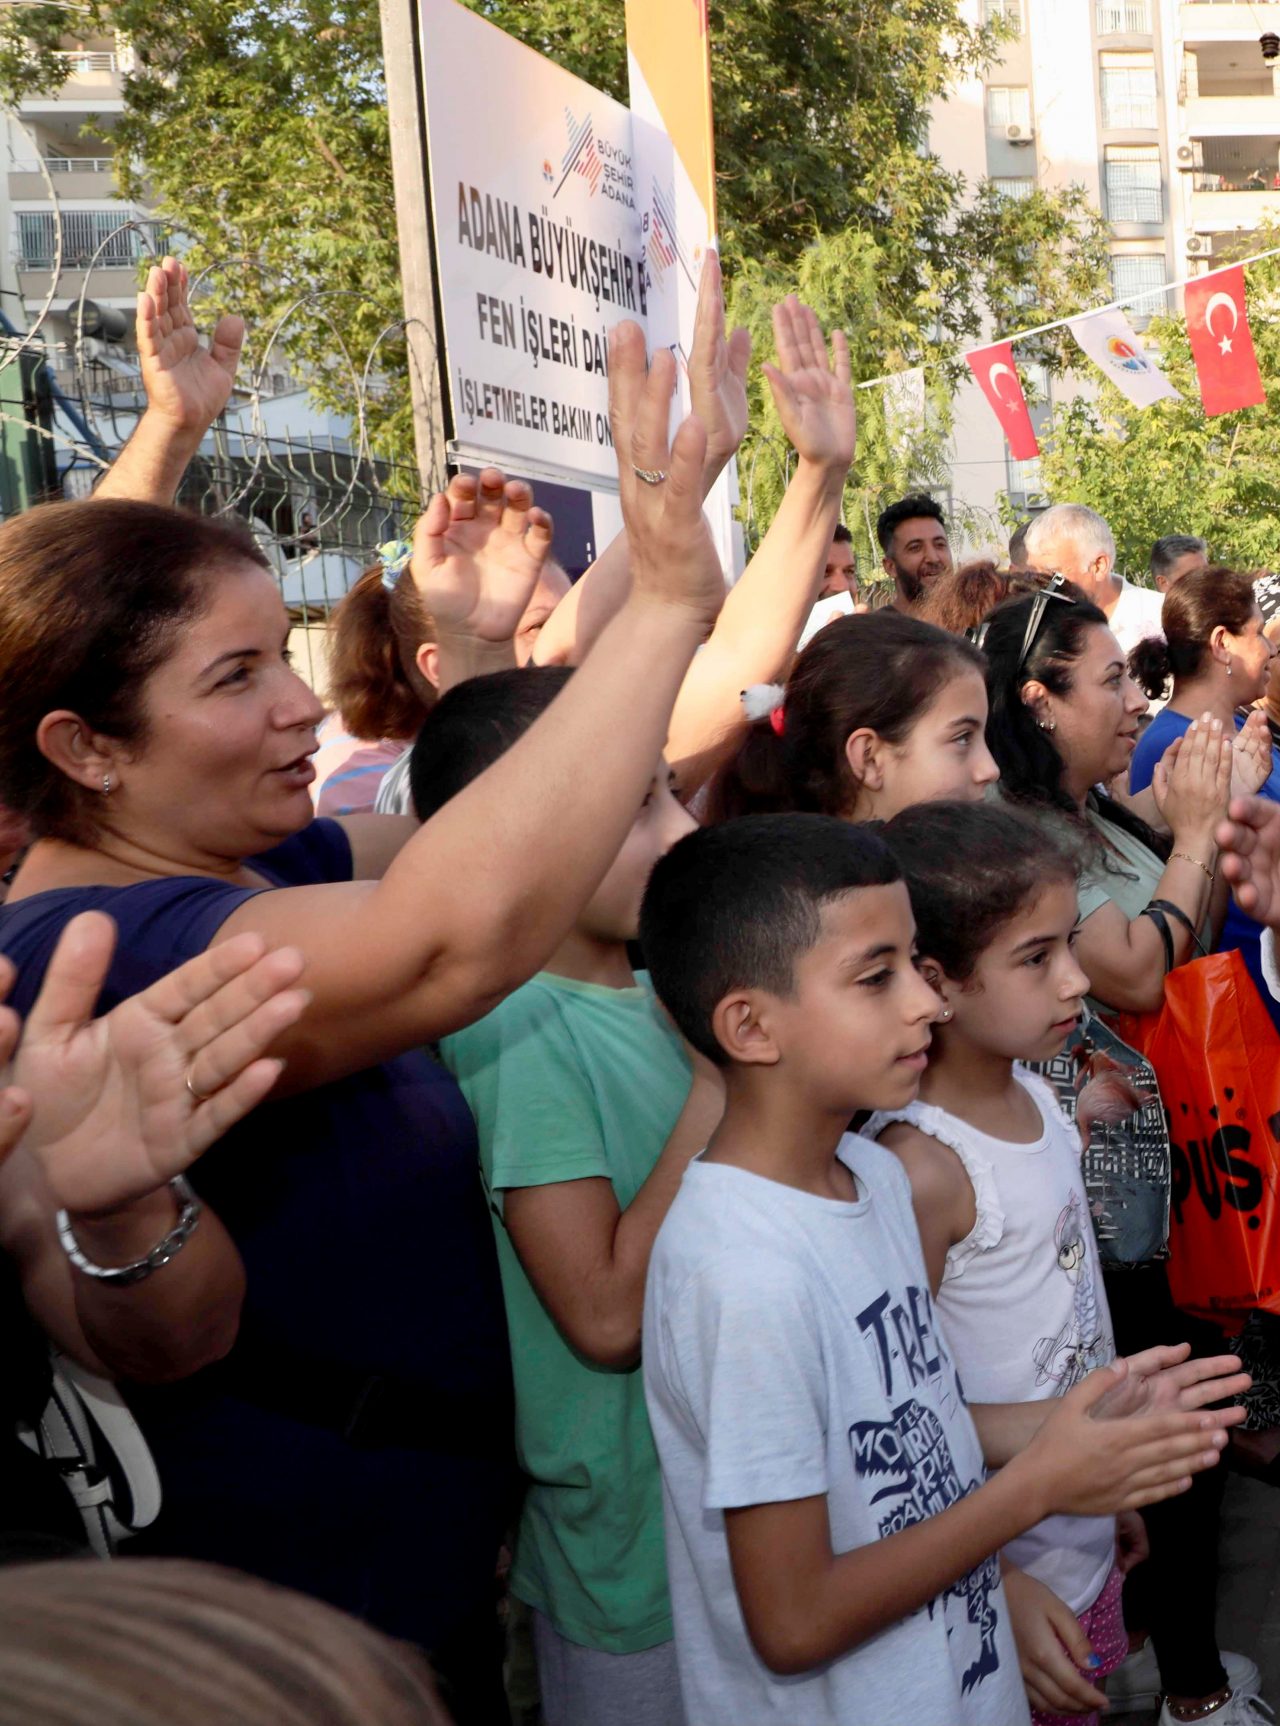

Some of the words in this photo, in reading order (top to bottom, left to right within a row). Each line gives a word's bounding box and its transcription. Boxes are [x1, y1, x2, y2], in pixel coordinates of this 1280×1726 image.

[597, 139, 633, 169] BÜYÜK
[603, 163, 634, 191] ŞEHİR
[601, 184, 636, 210] ADANA
[458, 180, 527, 269] ADANA
[528, 203, 637, 312] BÜYÜKŞEHİR
[476, 291, 516, 349] FEN
[519, 295, 579, 369] İŞLERİ
[582, 324, 609, 378] DAİ
[457, 367, 549, 434] İŞLETMELER
[551, 401, 593, 443] BAKIM
[596, 415, 614, 448] ON
